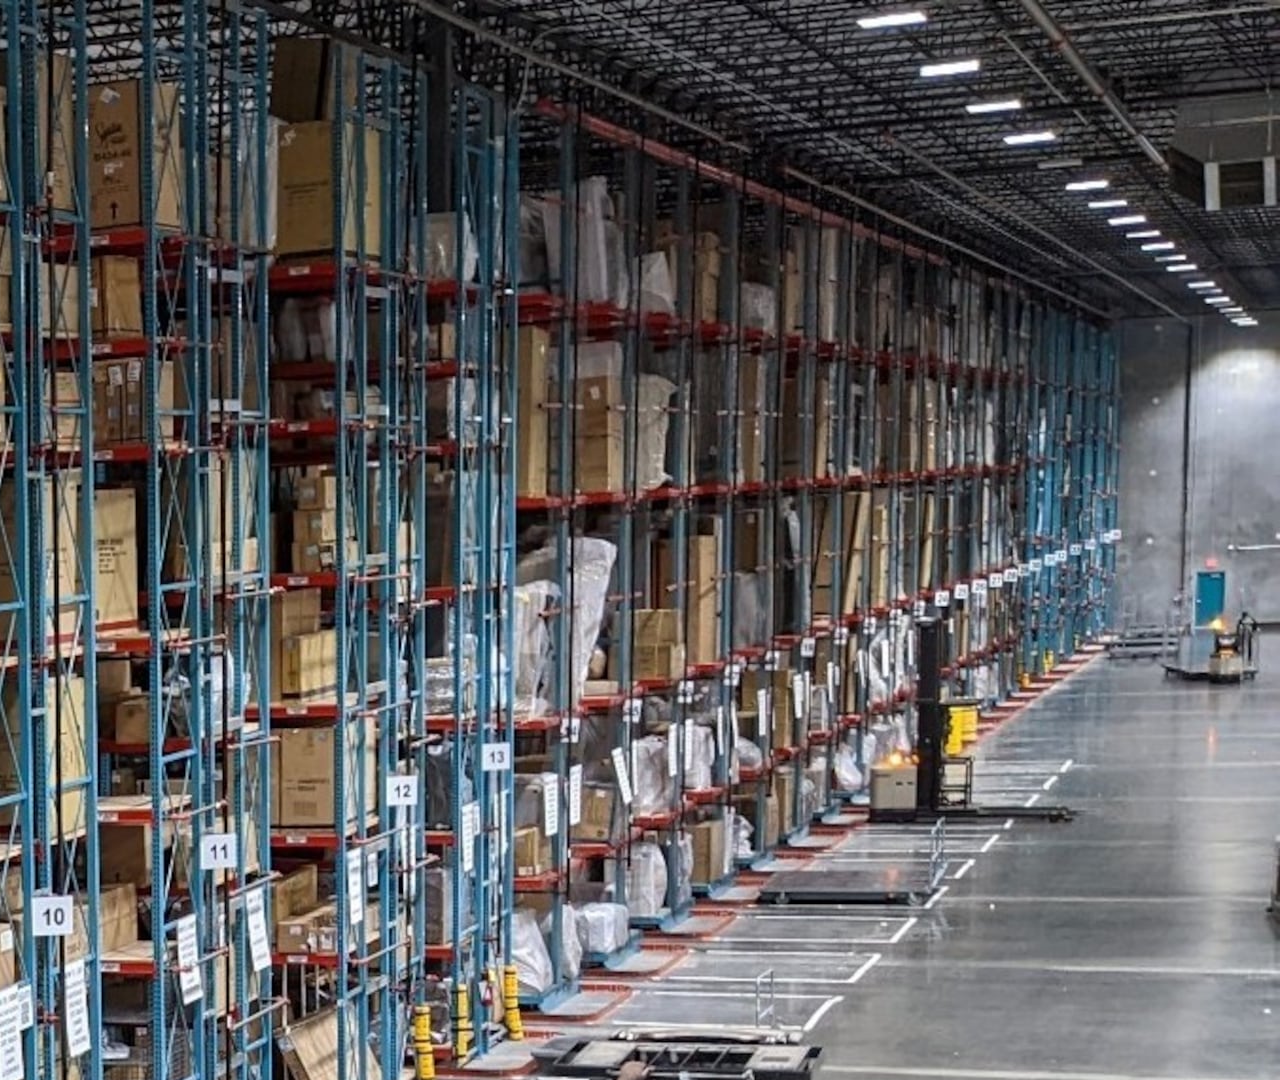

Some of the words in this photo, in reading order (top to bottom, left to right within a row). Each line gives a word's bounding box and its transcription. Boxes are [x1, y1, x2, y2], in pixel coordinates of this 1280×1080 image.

[490, 750, 505, 764] 13
[395, 784, 410, 798] 12
[210, 844, 228, 859] 11
[43, 908, 64, 926] 10
